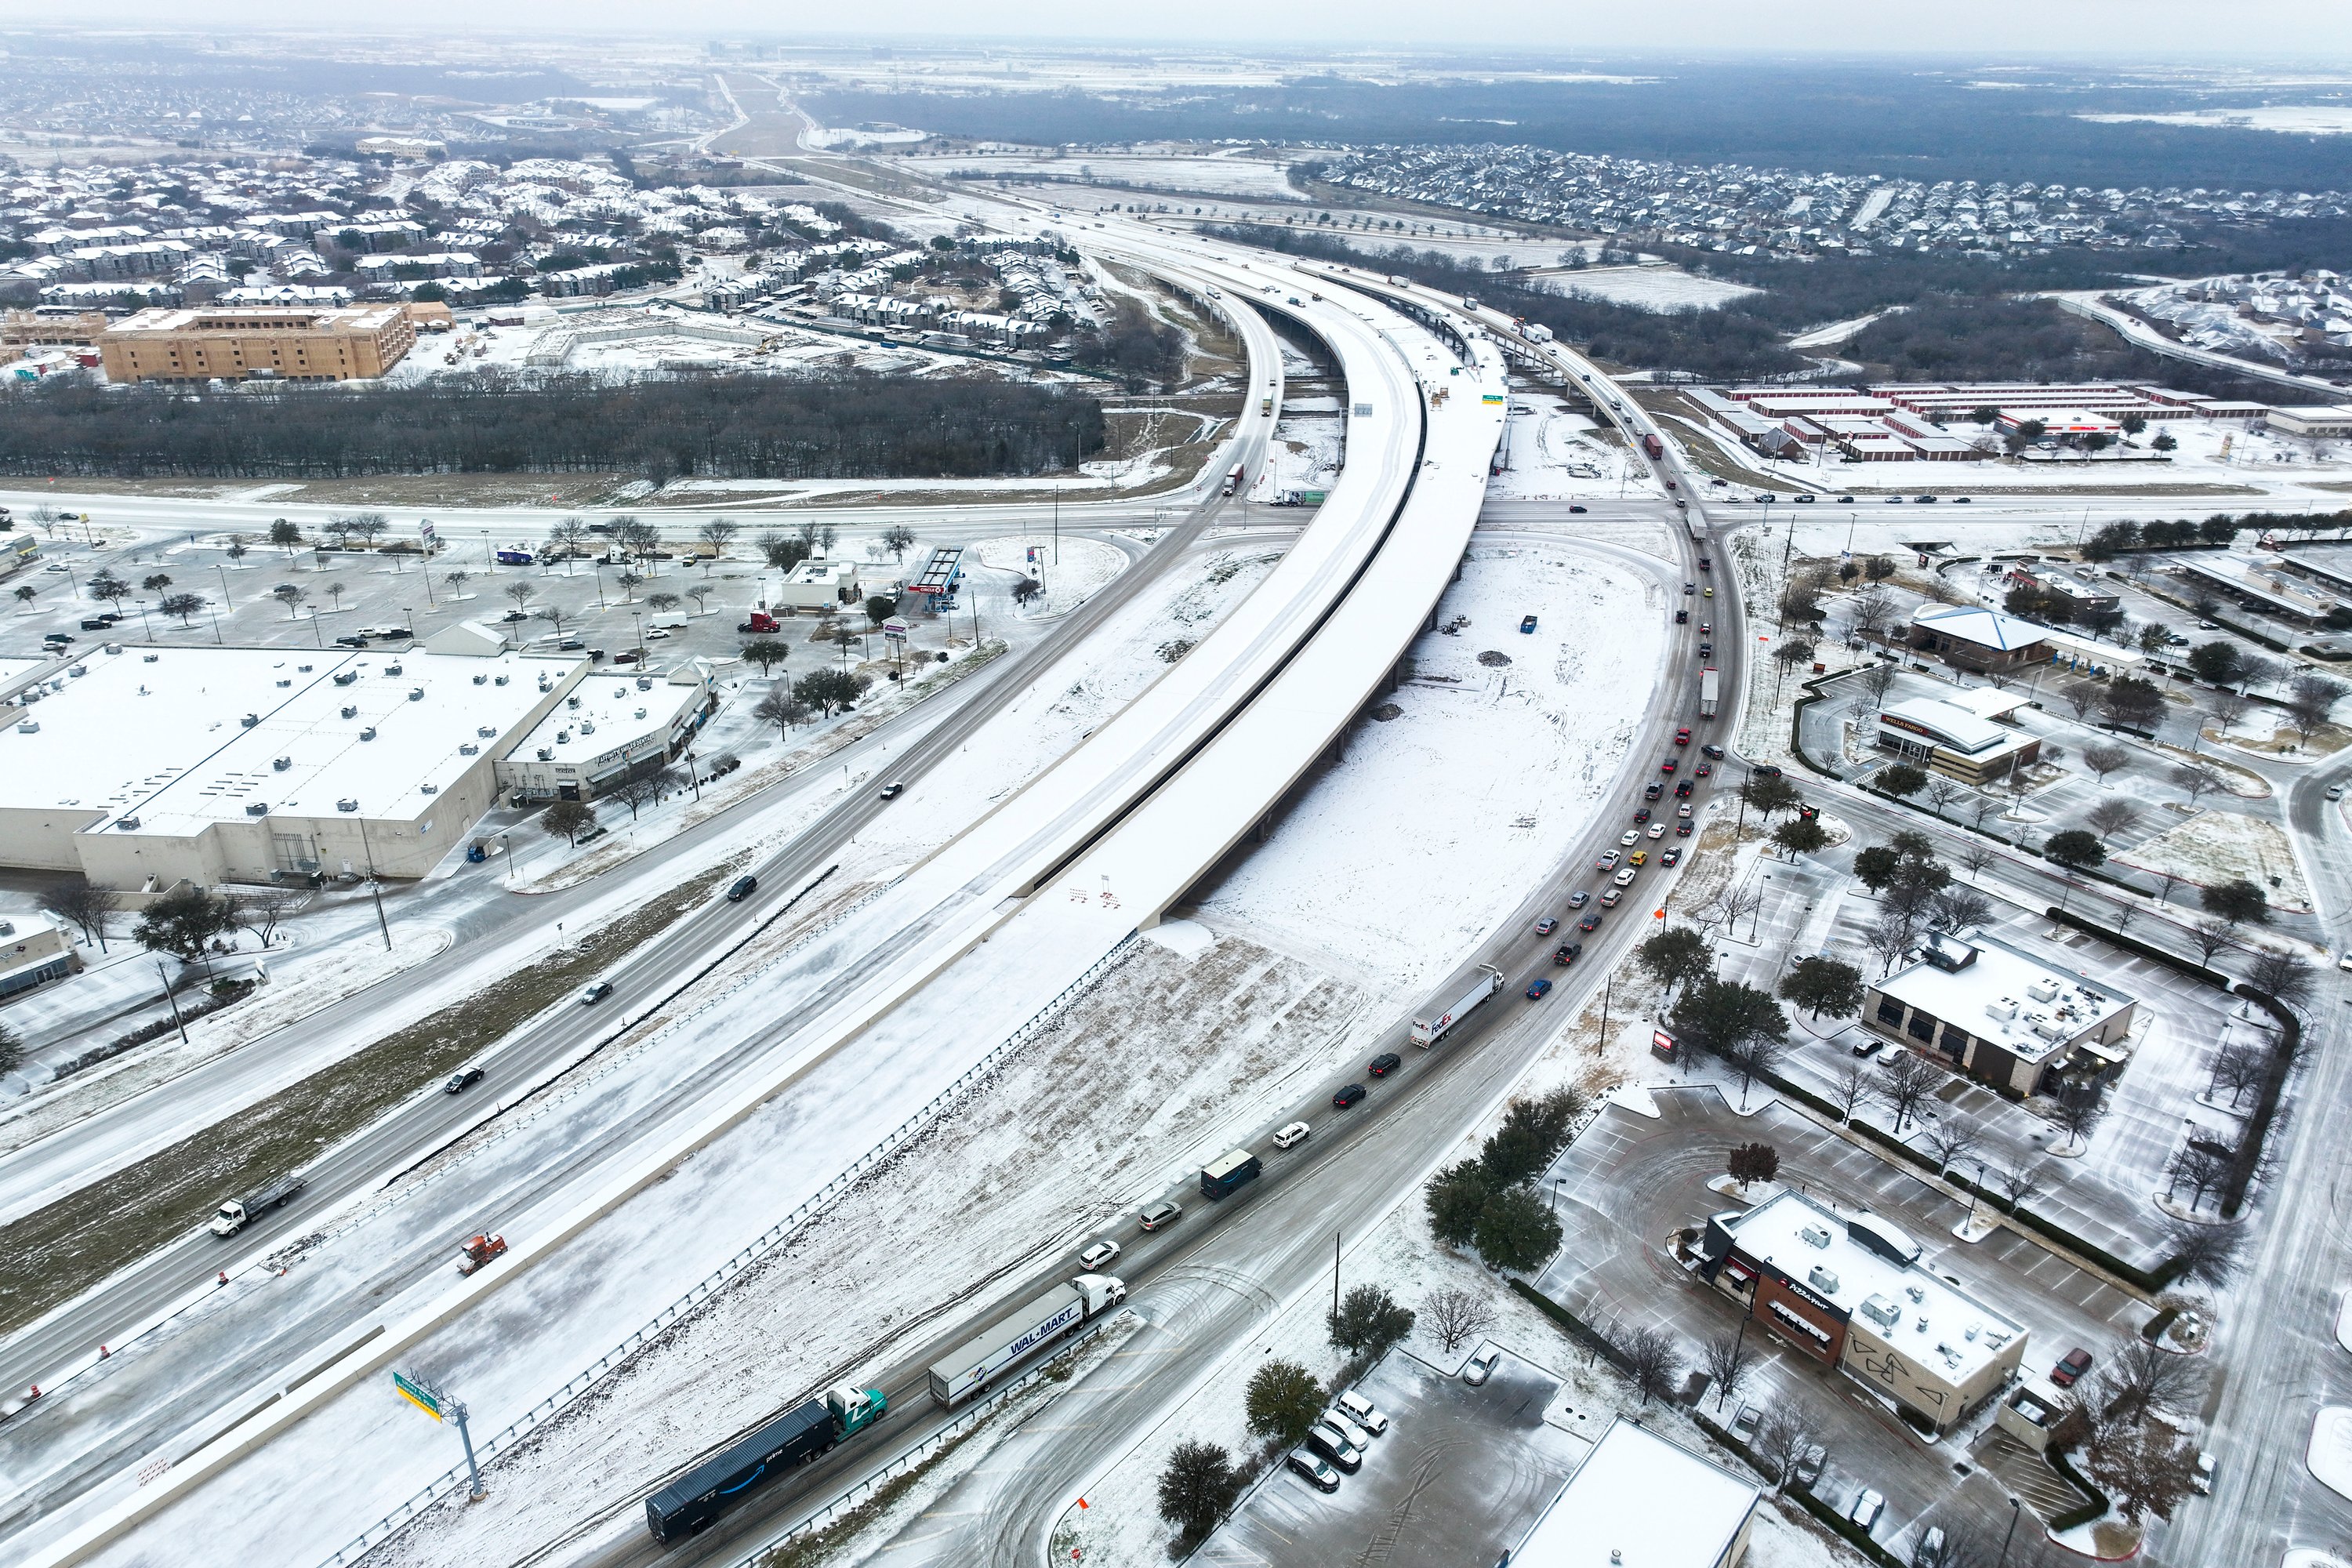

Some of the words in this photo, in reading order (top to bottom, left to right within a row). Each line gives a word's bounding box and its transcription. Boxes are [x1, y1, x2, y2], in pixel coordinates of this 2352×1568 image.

[1886, 717, 1904, 727] WELLS
[1904, 723, 1923, 733] FARGO
[600, 748, 620, 762] AFFINITY
[620, 742, 636, 753] SMILES
[636, 735, 652, 746] DENTAL
[1412, 1021, 1429, 1031] FedEx
[1432, 1014, 1451, 1036] FedEx
[766, 1449, 783, 1464] prime
